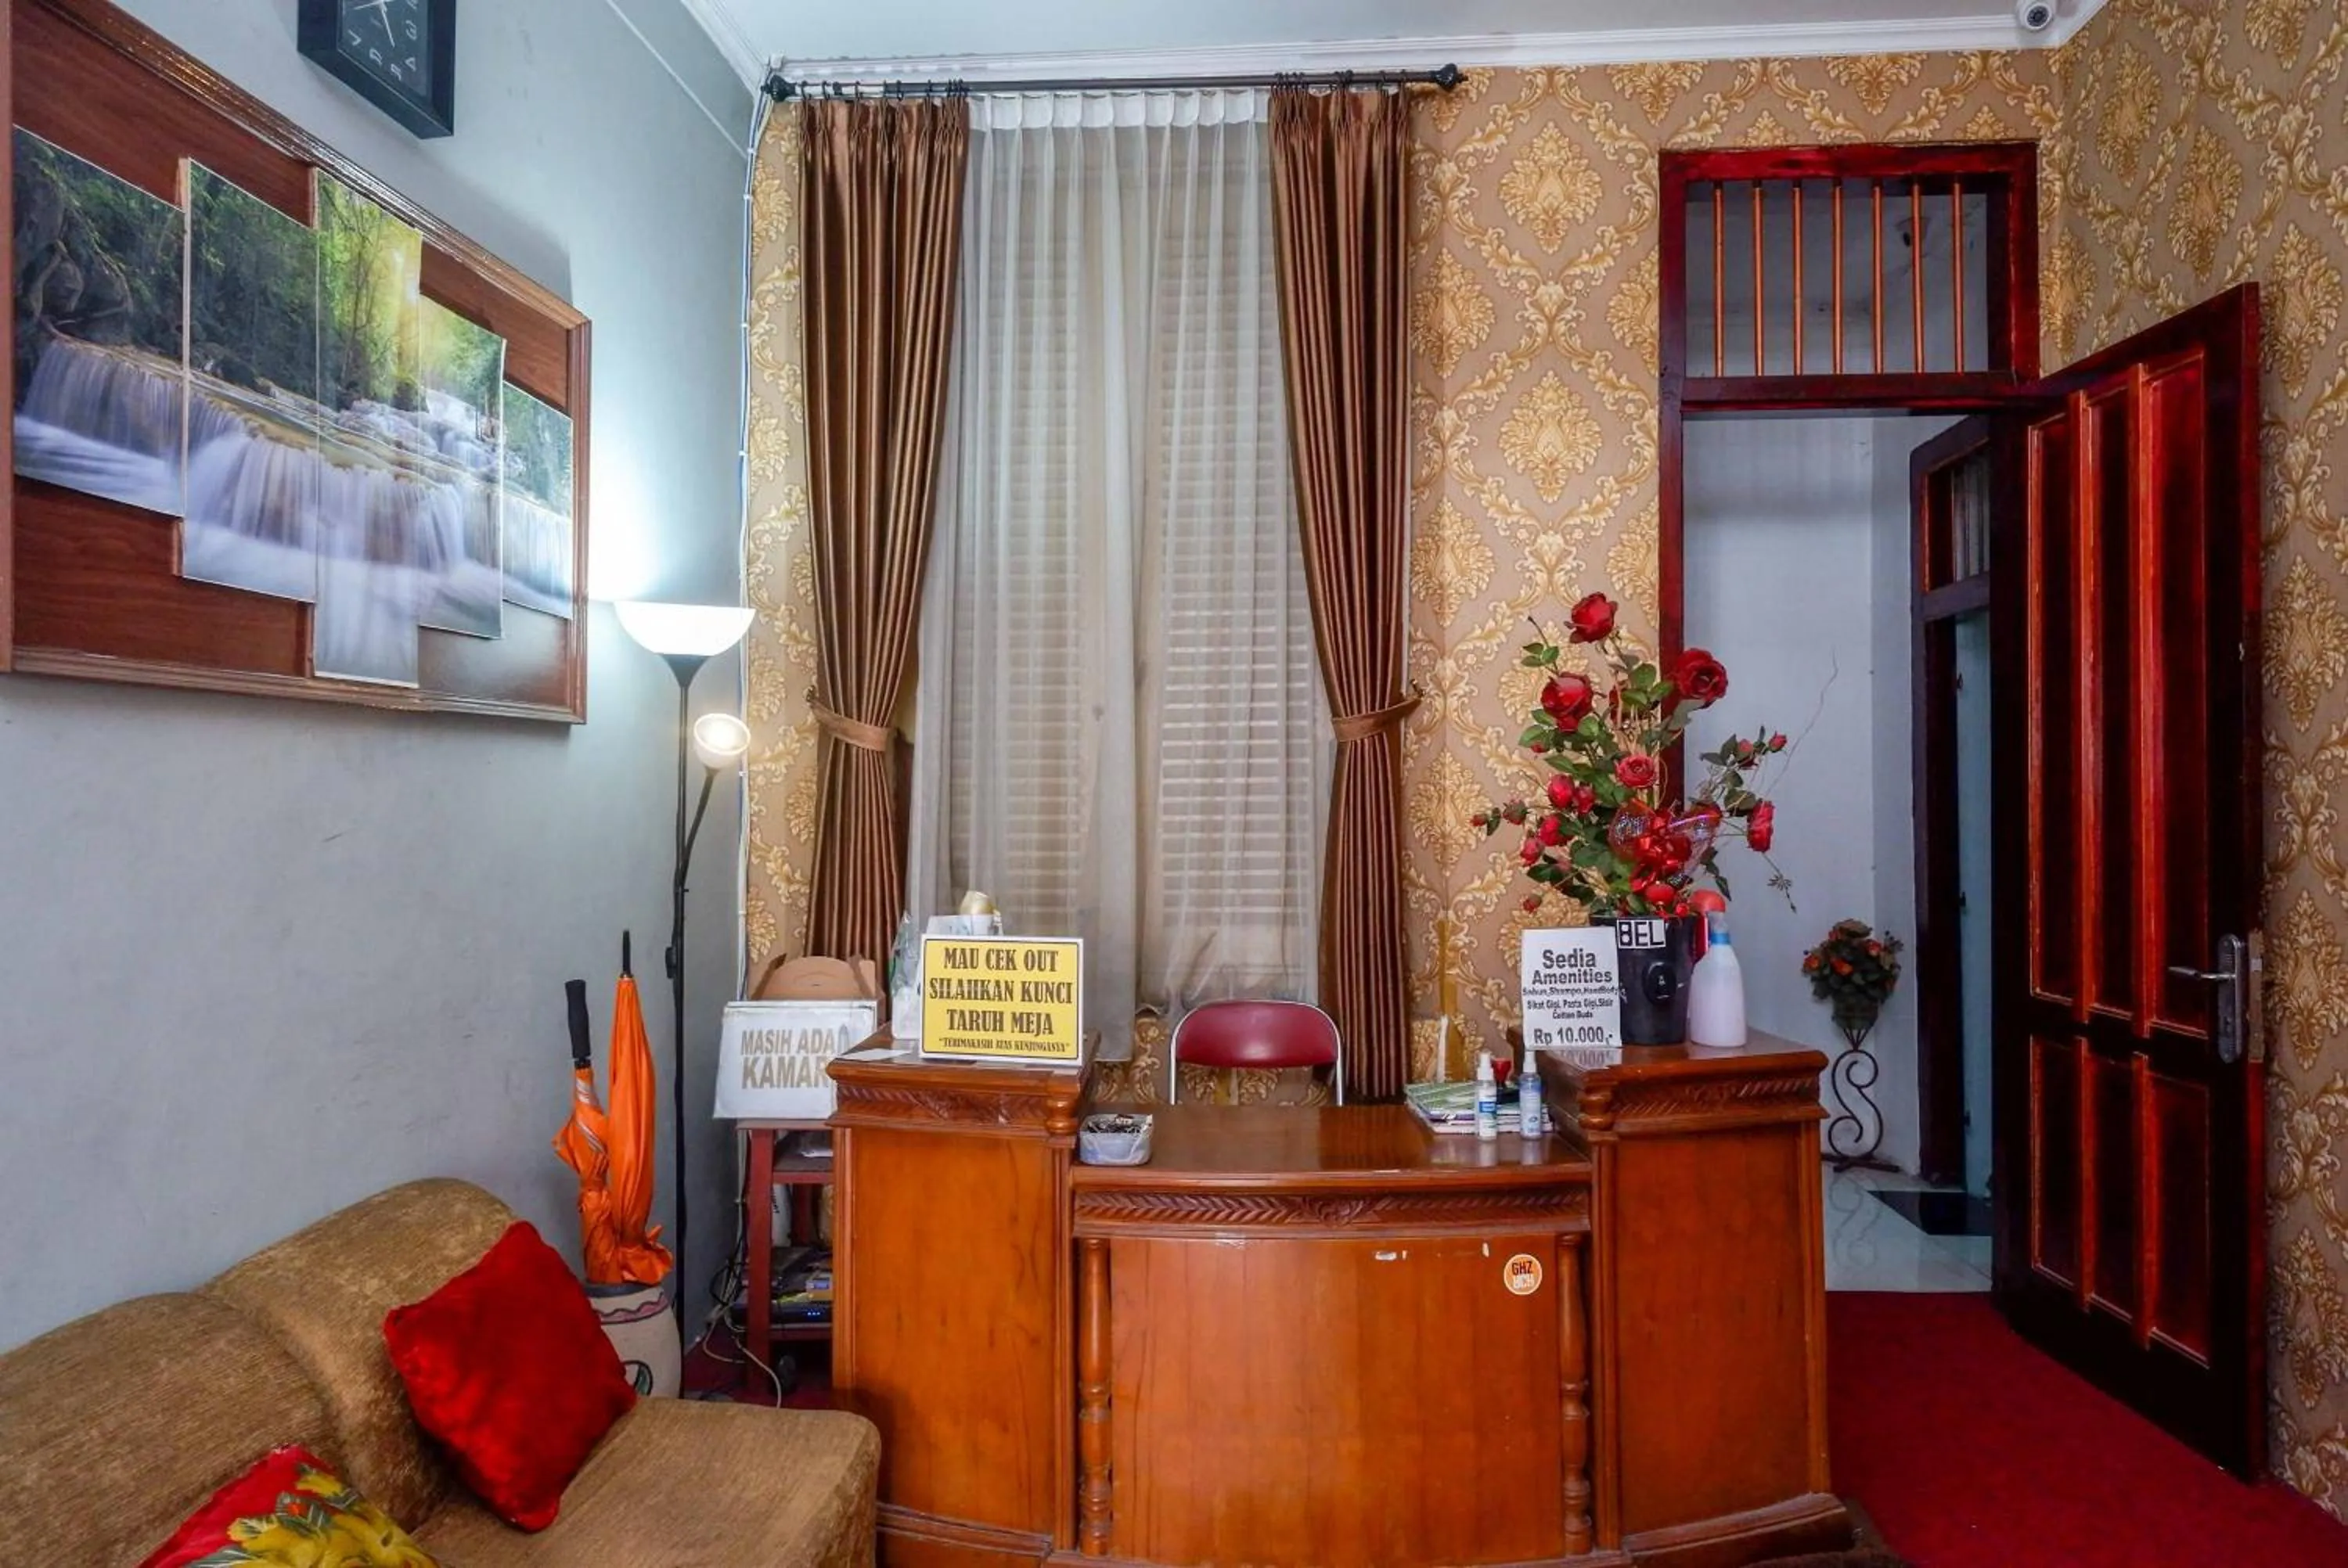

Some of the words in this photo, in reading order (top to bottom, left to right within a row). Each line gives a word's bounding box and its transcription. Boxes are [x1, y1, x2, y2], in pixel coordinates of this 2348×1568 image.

[1619, 921, 1664, 947] BEL
[944, 948, 979, 969] MAU
[985, 949, 1017, 971] CEK
[1023, 950, 1058, 972] OUT
[1543, 948, 1597, 969] Sedia
[1532, 969, 1613, 986] Amenities
[929, 977, 1014, 1002] SILAHKAN
[1020, 980, 1072, 1004] KUNCI
[947, 1009, 1004, 1033] TARUH
[1011, 1012, 1053, 1037] MEJA
[740, 1028, 792, 1056] MASIH
[797, 1027, 835, 1056] ADA
[1534, 1028, 1552, 1046] Rp
[1511, 1261, 1533, 1275] GHZ
